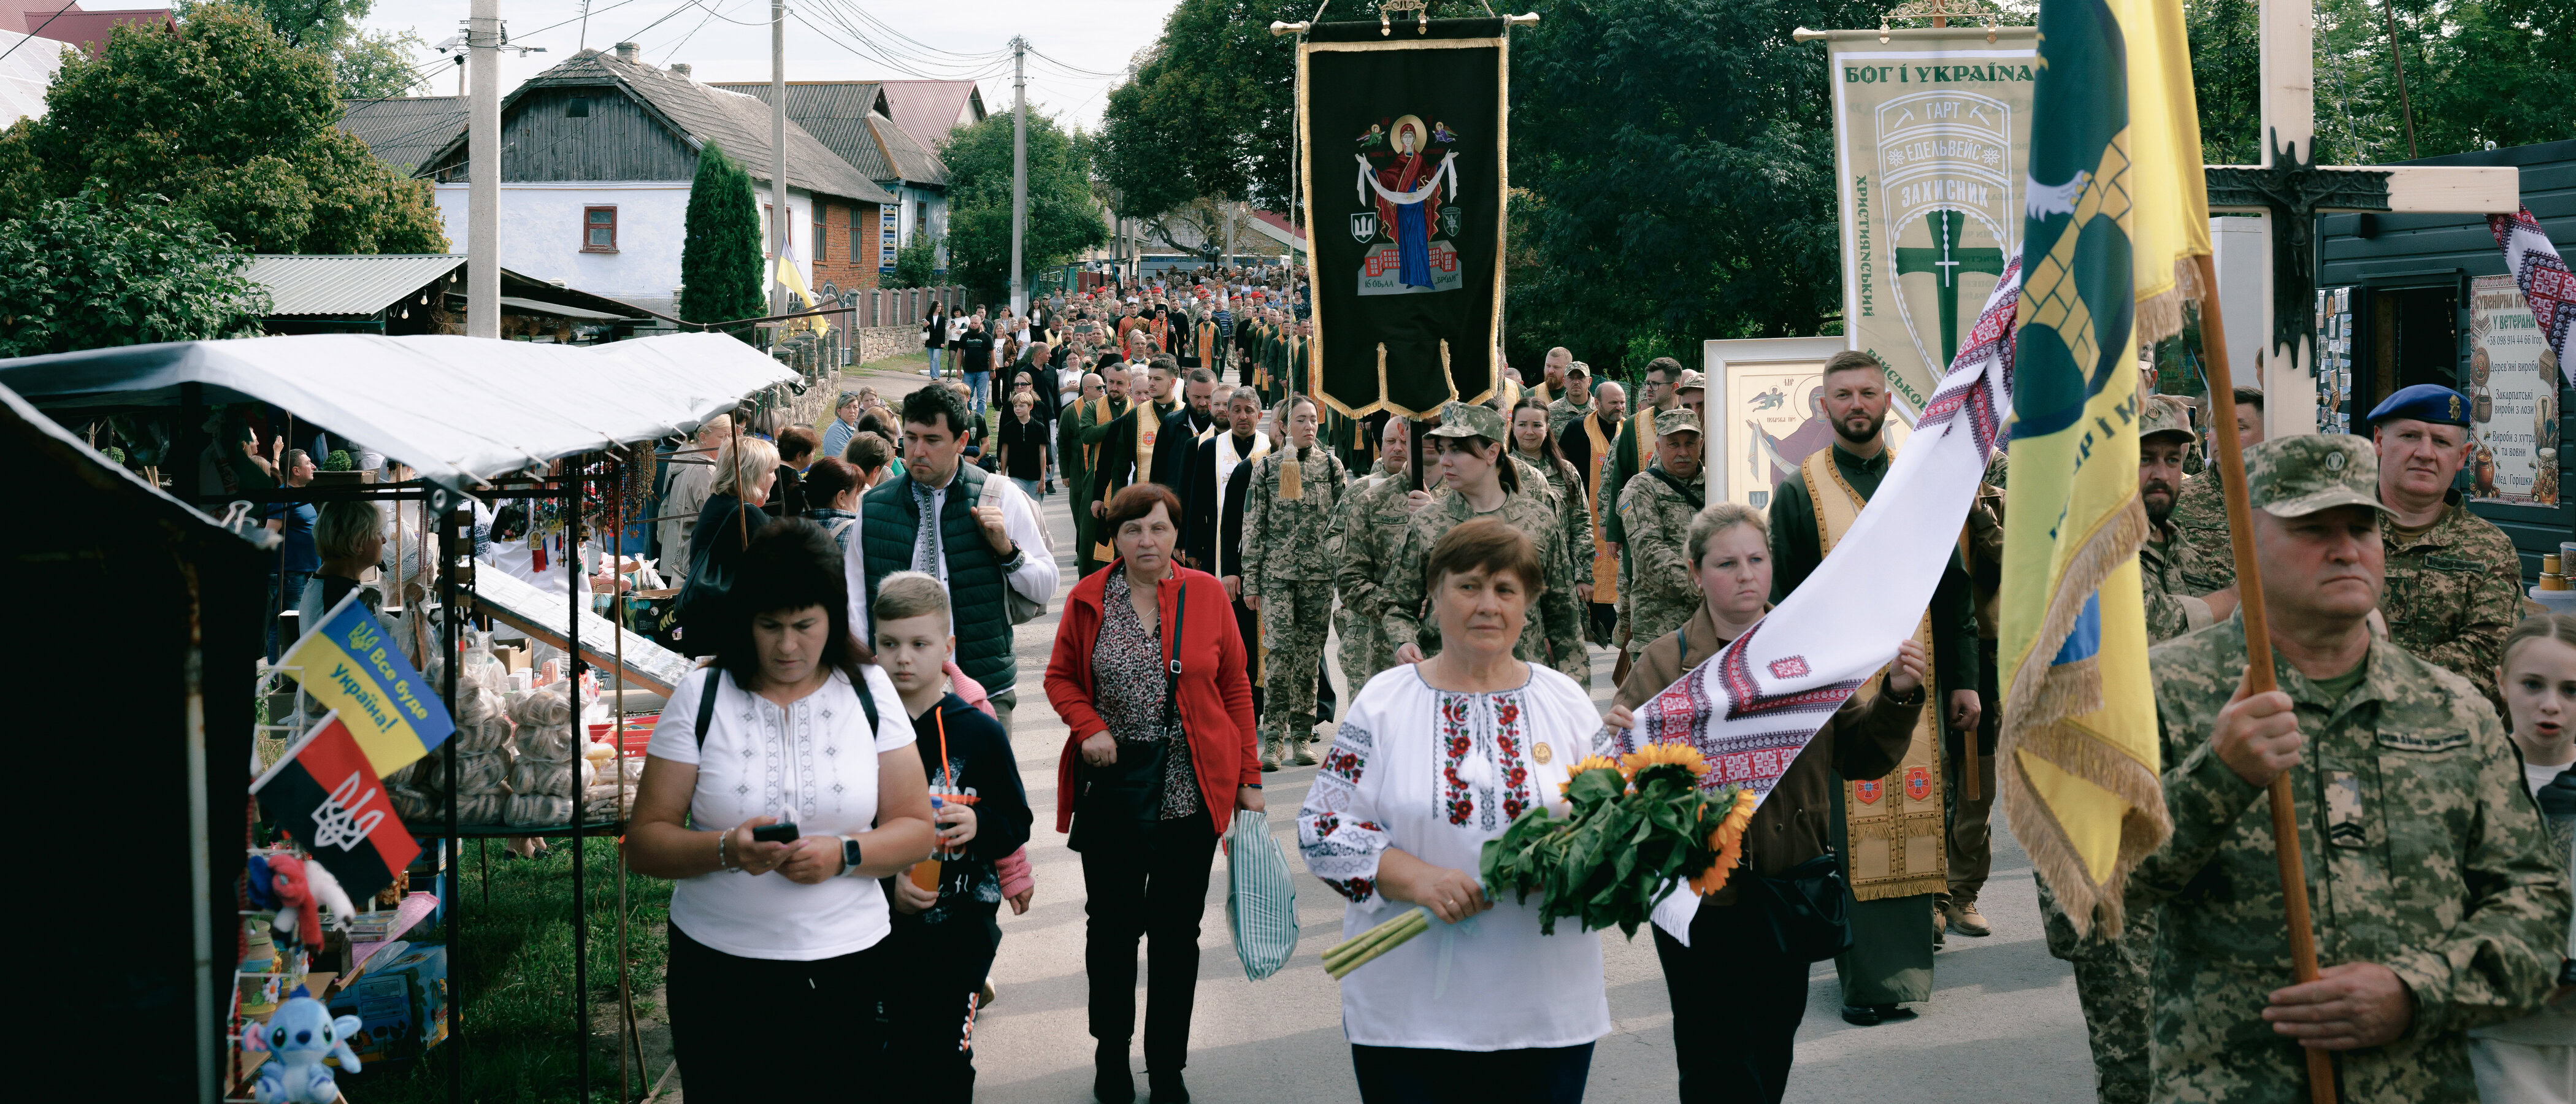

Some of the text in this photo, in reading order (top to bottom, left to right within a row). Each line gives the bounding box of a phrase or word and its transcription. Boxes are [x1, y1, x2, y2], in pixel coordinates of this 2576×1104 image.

[1844, 65, 1894, 84] БОГ
[1899, 64, 1909, 83] І
[1914, 62, 2035, 83] УКРАЇНА
[1925, 101, 1961, 120] ГАРТ
[1904, 138, 1982, 162] ЕДЕЛЬВЕЙС
[1901, 179, 1989, 209] ЗАХИСНИК
[1856, 174, 1875, 318] ХРИСТИЯНСЬКИЙ
[2475, 291, 2513, 310] СУВЕНІРНА
[2493, 314, 2536, 330] У ВЕТЕРАНА
[2486, 334, 2542, 347] +38 098 914 44 66 Ігор
[2518, 360, 2539, 374] вироби
[2496, 388, 2533, 402] Закарпатські
[2494, 402, 2534, 417] вироби з лози
[2493, 431, 2536, 446] Вироби з хутра
[2501, 447, 2526, 457] та вовни
[2510, 473, 2532, 488] Горішки
[329, 662, 399, 734] Україна!
